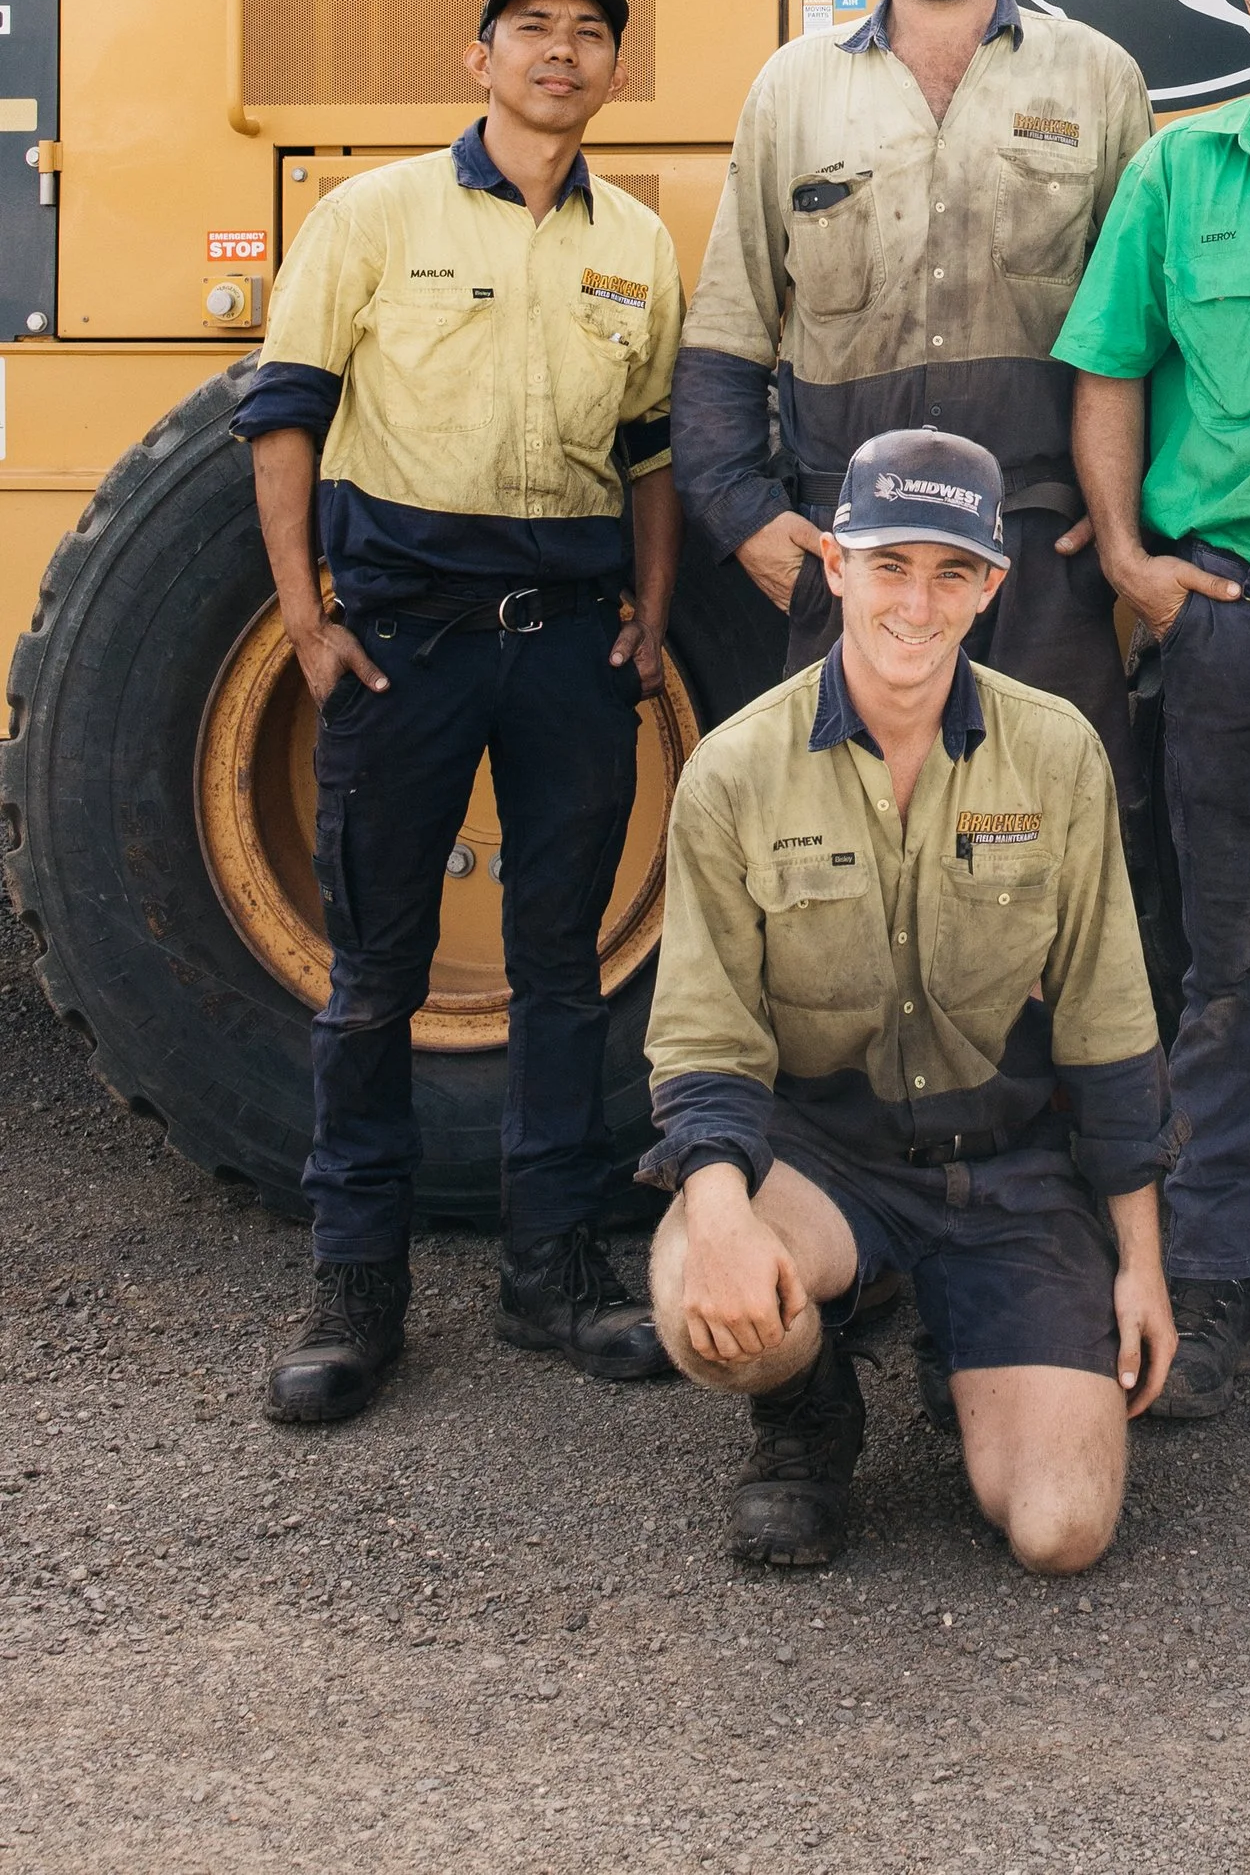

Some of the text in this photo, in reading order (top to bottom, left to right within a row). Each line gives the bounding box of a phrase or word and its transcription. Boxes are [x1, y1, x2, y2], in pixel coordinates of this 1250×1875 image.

[1013, 112, 1080, 139] BRACKENS
[815, 160, 845, 174] AYDEN
[209, 232, 265, 240] EMERGENCY
[1201, 230, 1237, 243] LEEROY
[209, 241, 265, 257] STOP
[410, 269, 454, 278] MARLON
[581, 268, 649, 300] BRACKENS
[904, 479, 983, 506] MIDWEST
[957, 811, 1042, 833] BRACKENS
[976, 831, 1038, 843] FIELD MAINTENANCE
[834, 855, 853, 864] Bisley
